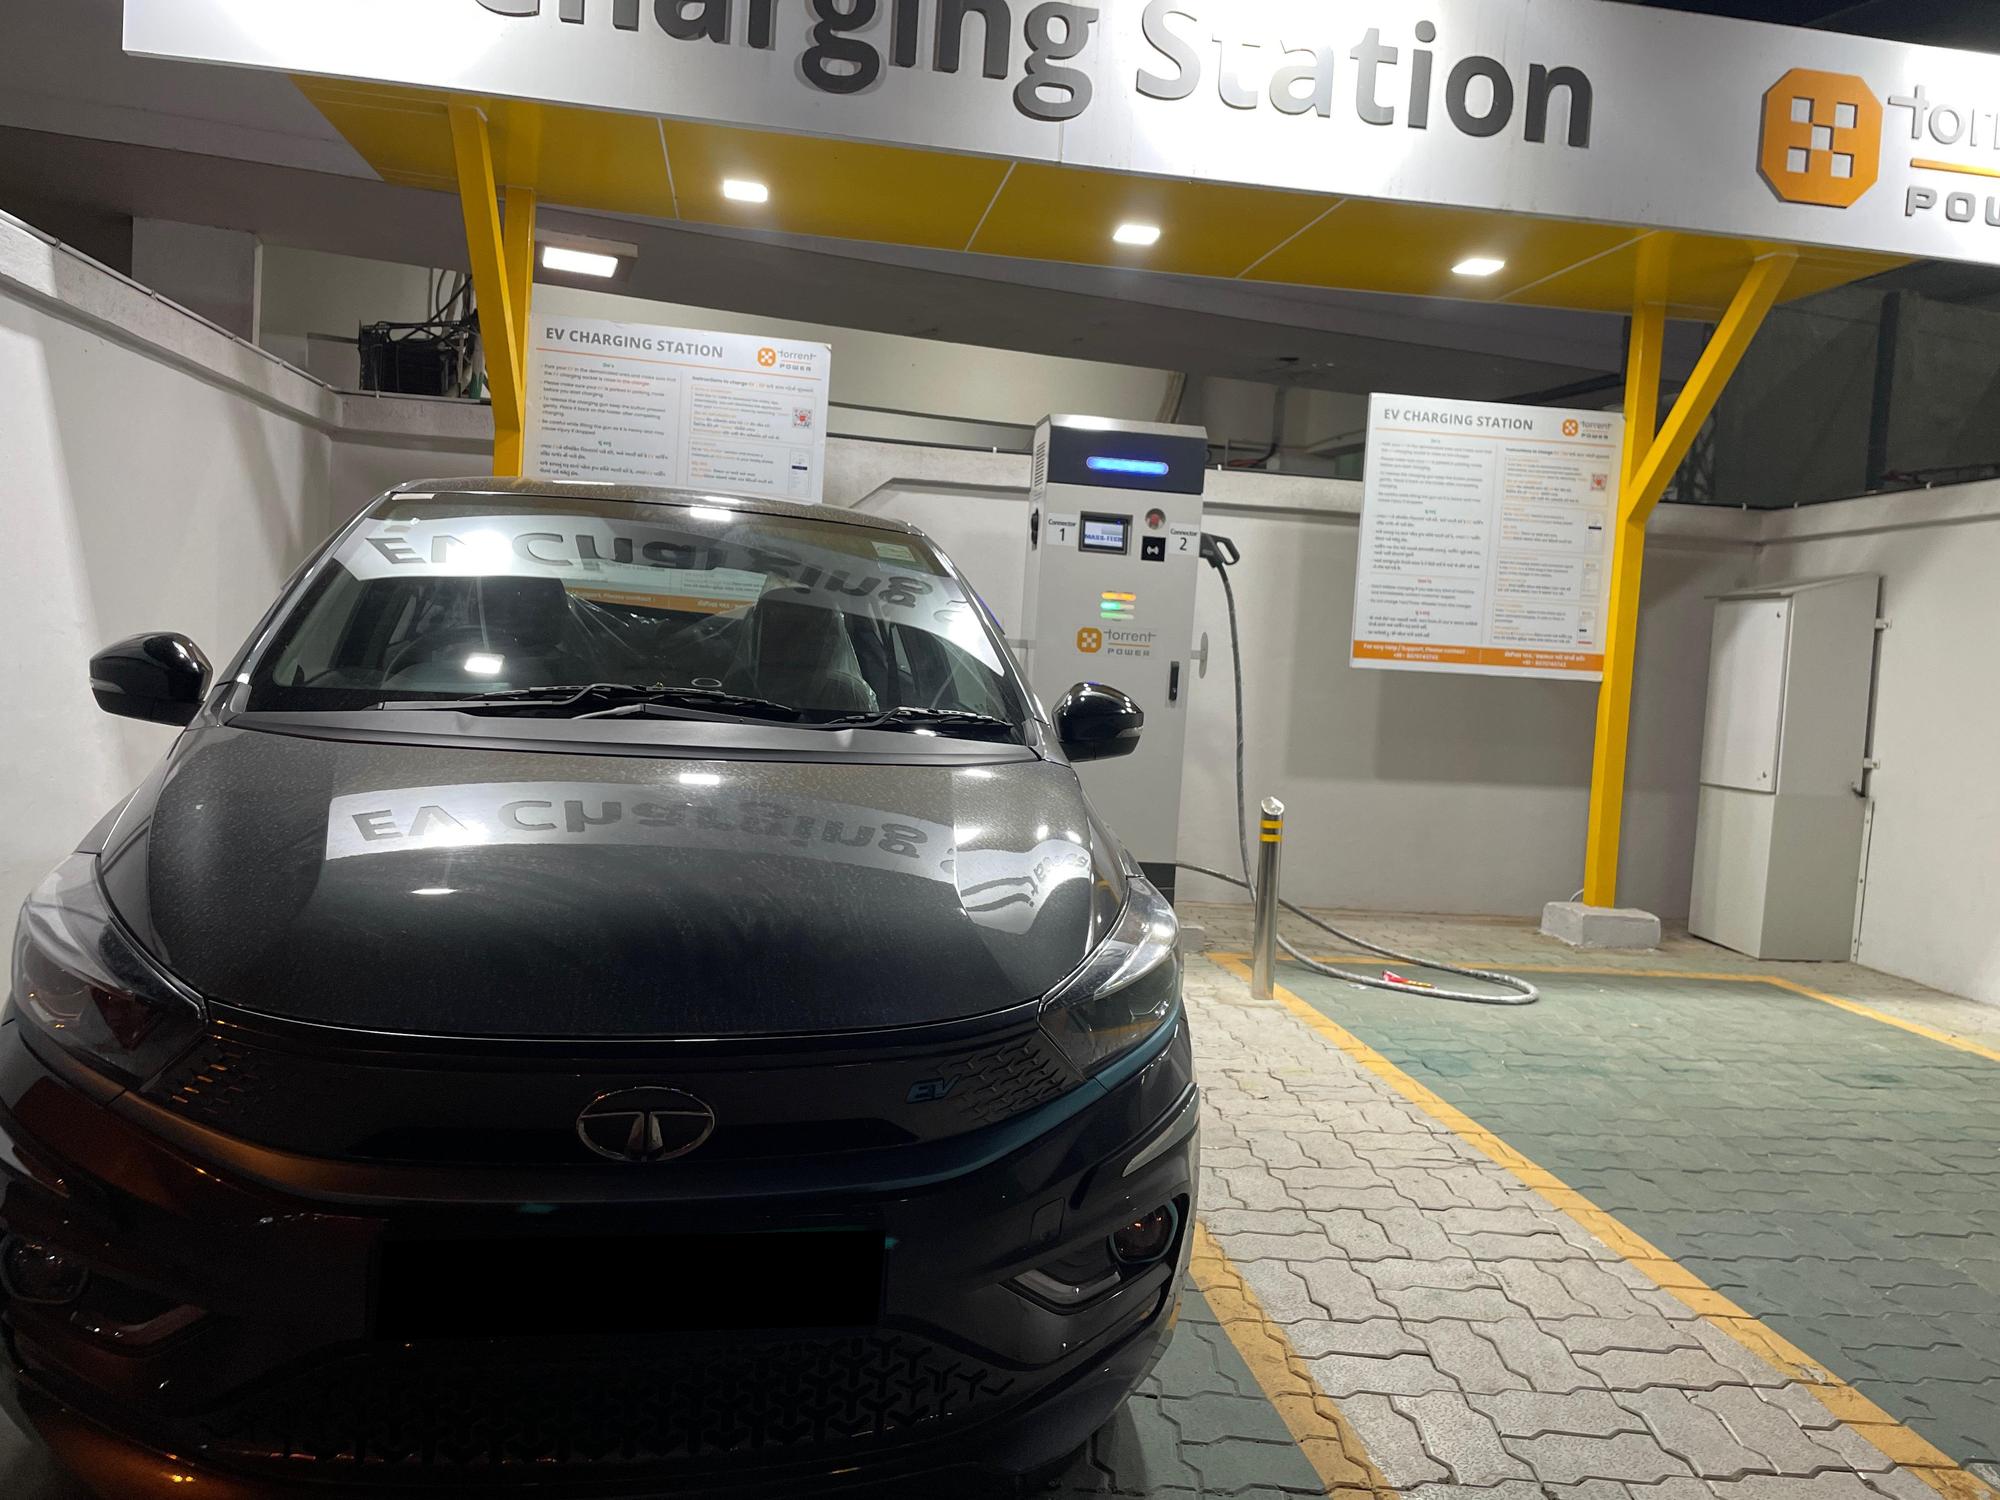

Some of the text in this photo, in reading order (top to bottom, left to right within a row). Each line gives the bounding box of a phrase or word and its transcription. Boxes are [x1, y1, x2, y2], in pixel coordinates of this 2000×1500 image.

[475, 0, 1593, 148] aging Station
[546, 327, 723, 358] EV CHARGING STATION
[778, 350, 816, 361] torrent
[779, 363, 812, 372] POWER
[1384, 409, 1533, 430] EV CHARGING STATION
[1060, 528, 1065, 542] 1
[1179, 537, 1187, 551] 2
[1104, 629, 1157, 642] torrent
[1107, 647, 1150, 656] POWER
[906, 1074, 961, 1104] EV
